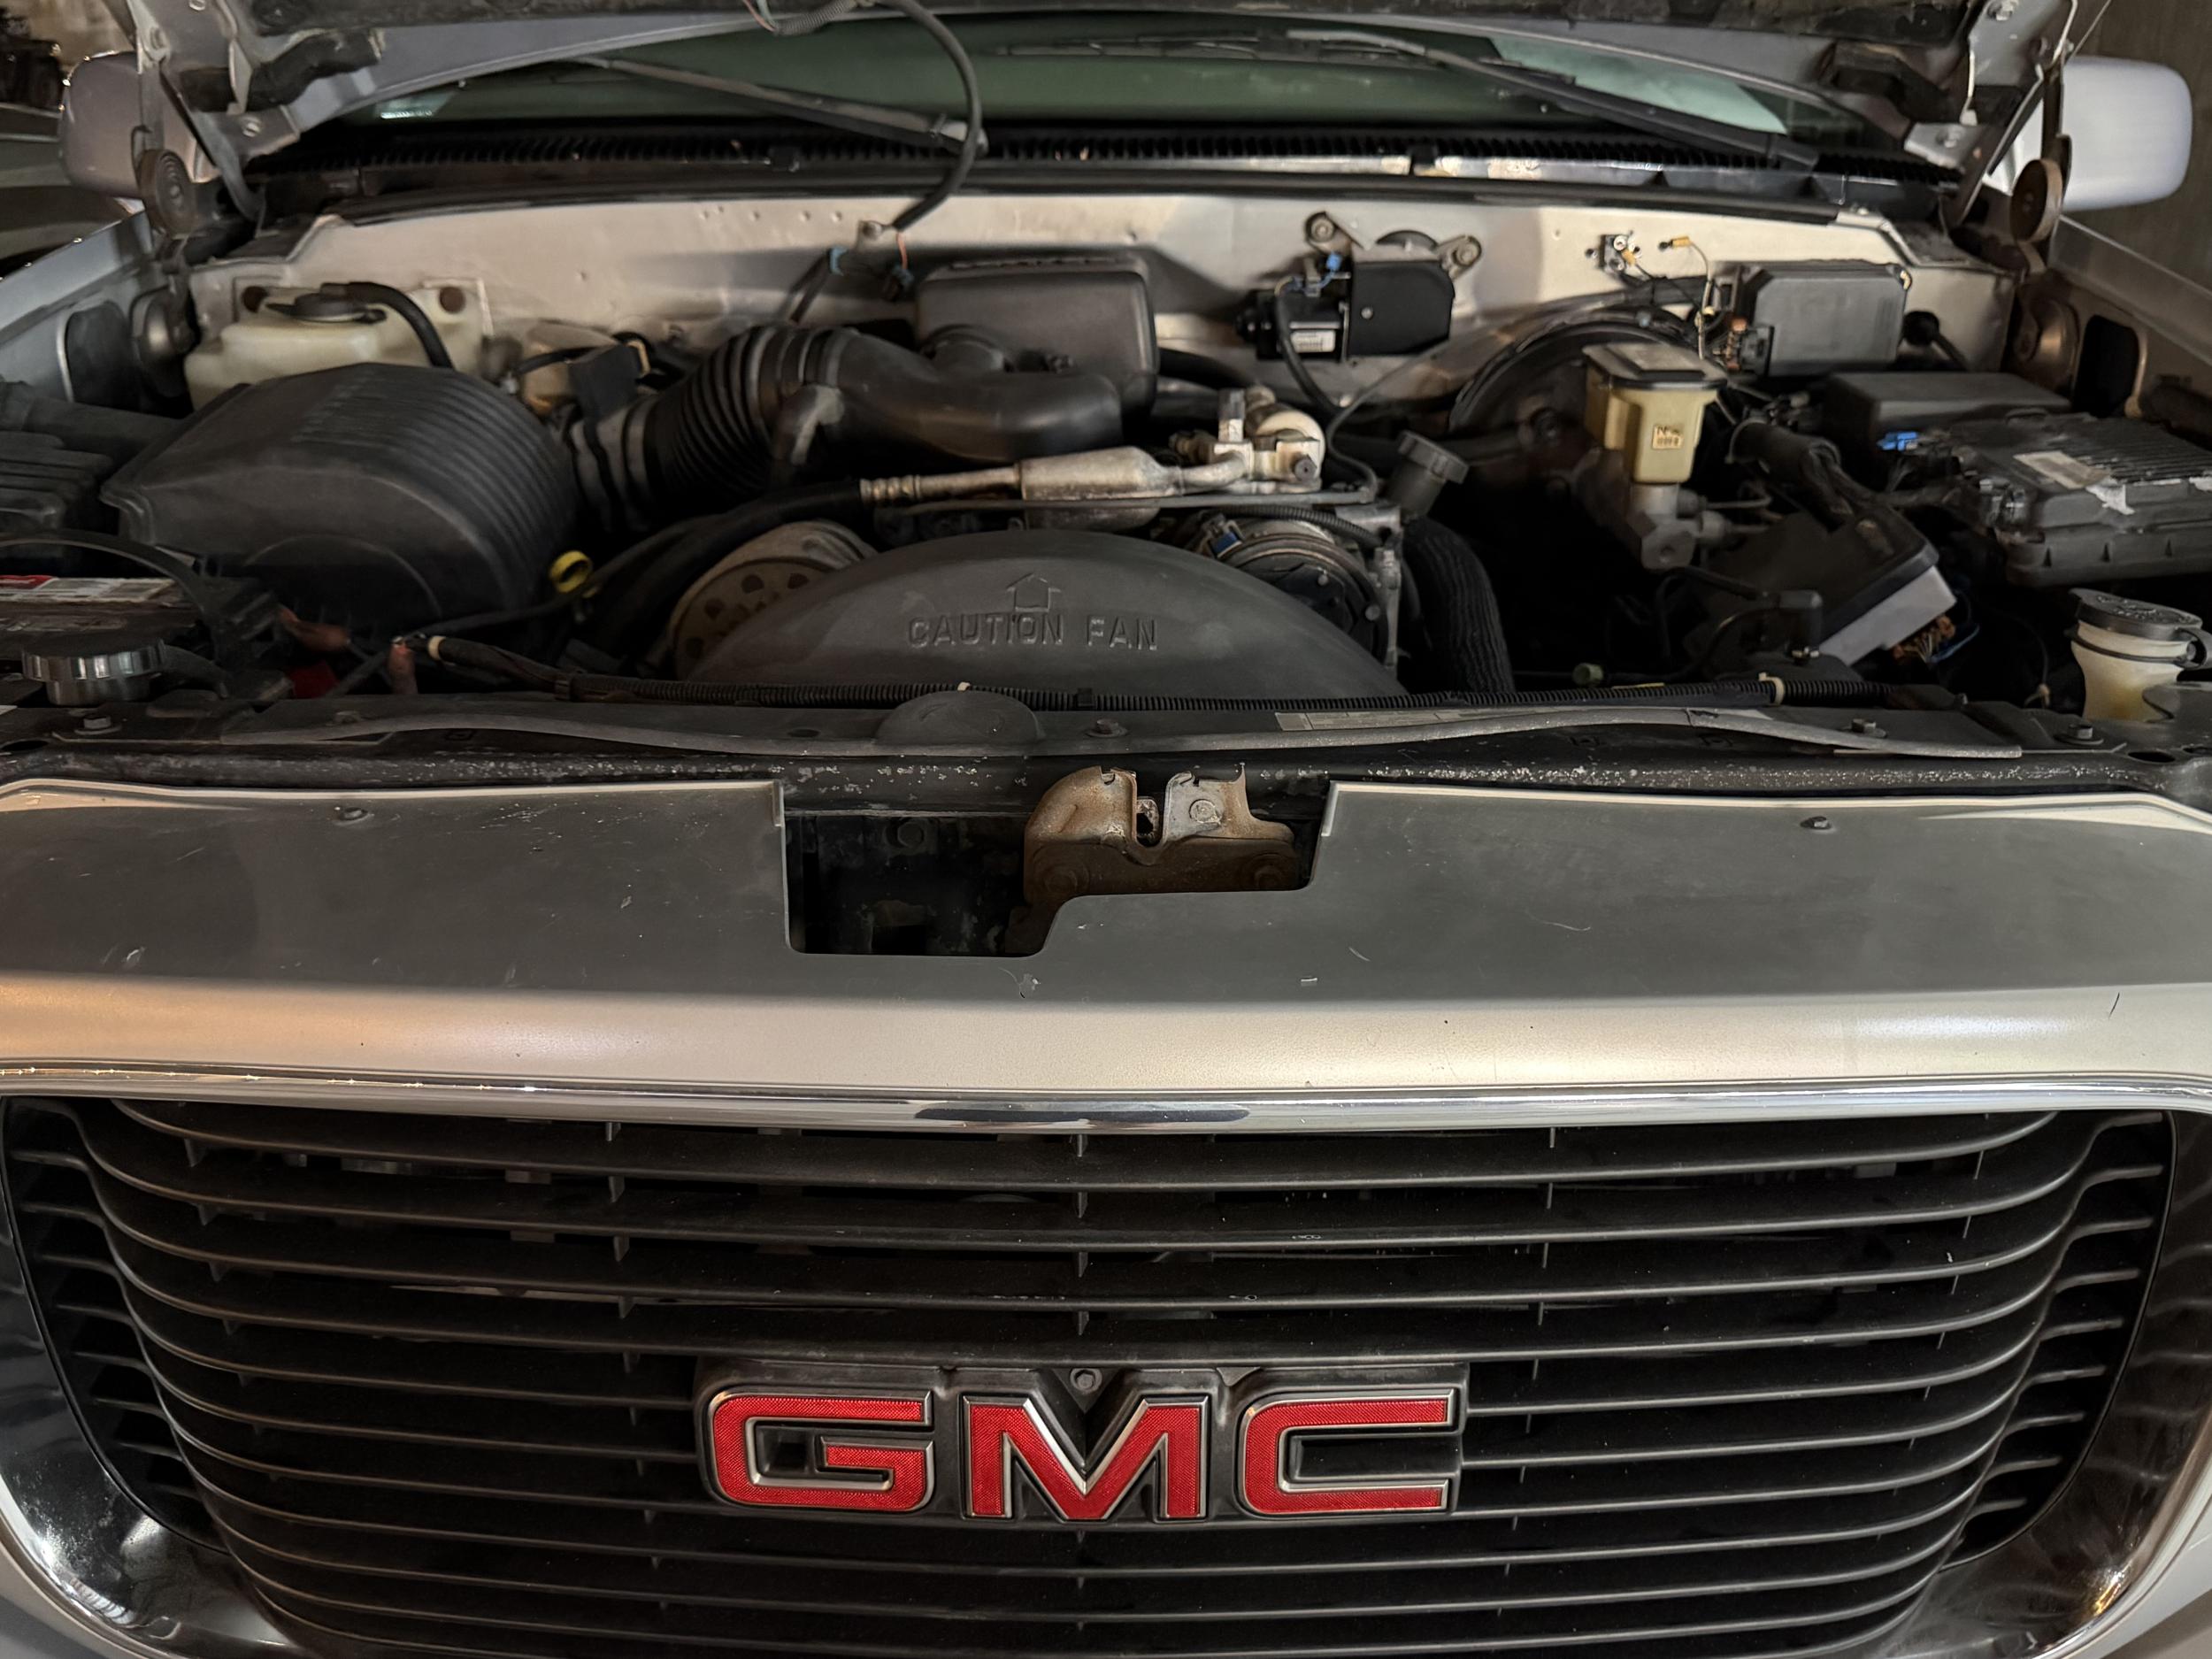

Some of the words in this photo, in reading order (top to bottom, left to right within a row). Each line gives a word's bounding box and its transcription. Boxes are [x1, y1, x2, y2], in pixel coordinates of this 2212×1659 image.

[908, 613, 1064, 649] CAUTION
[1086, 617, 1158, 651] FAN
[709, 1390, 1457, 1521] GMC
